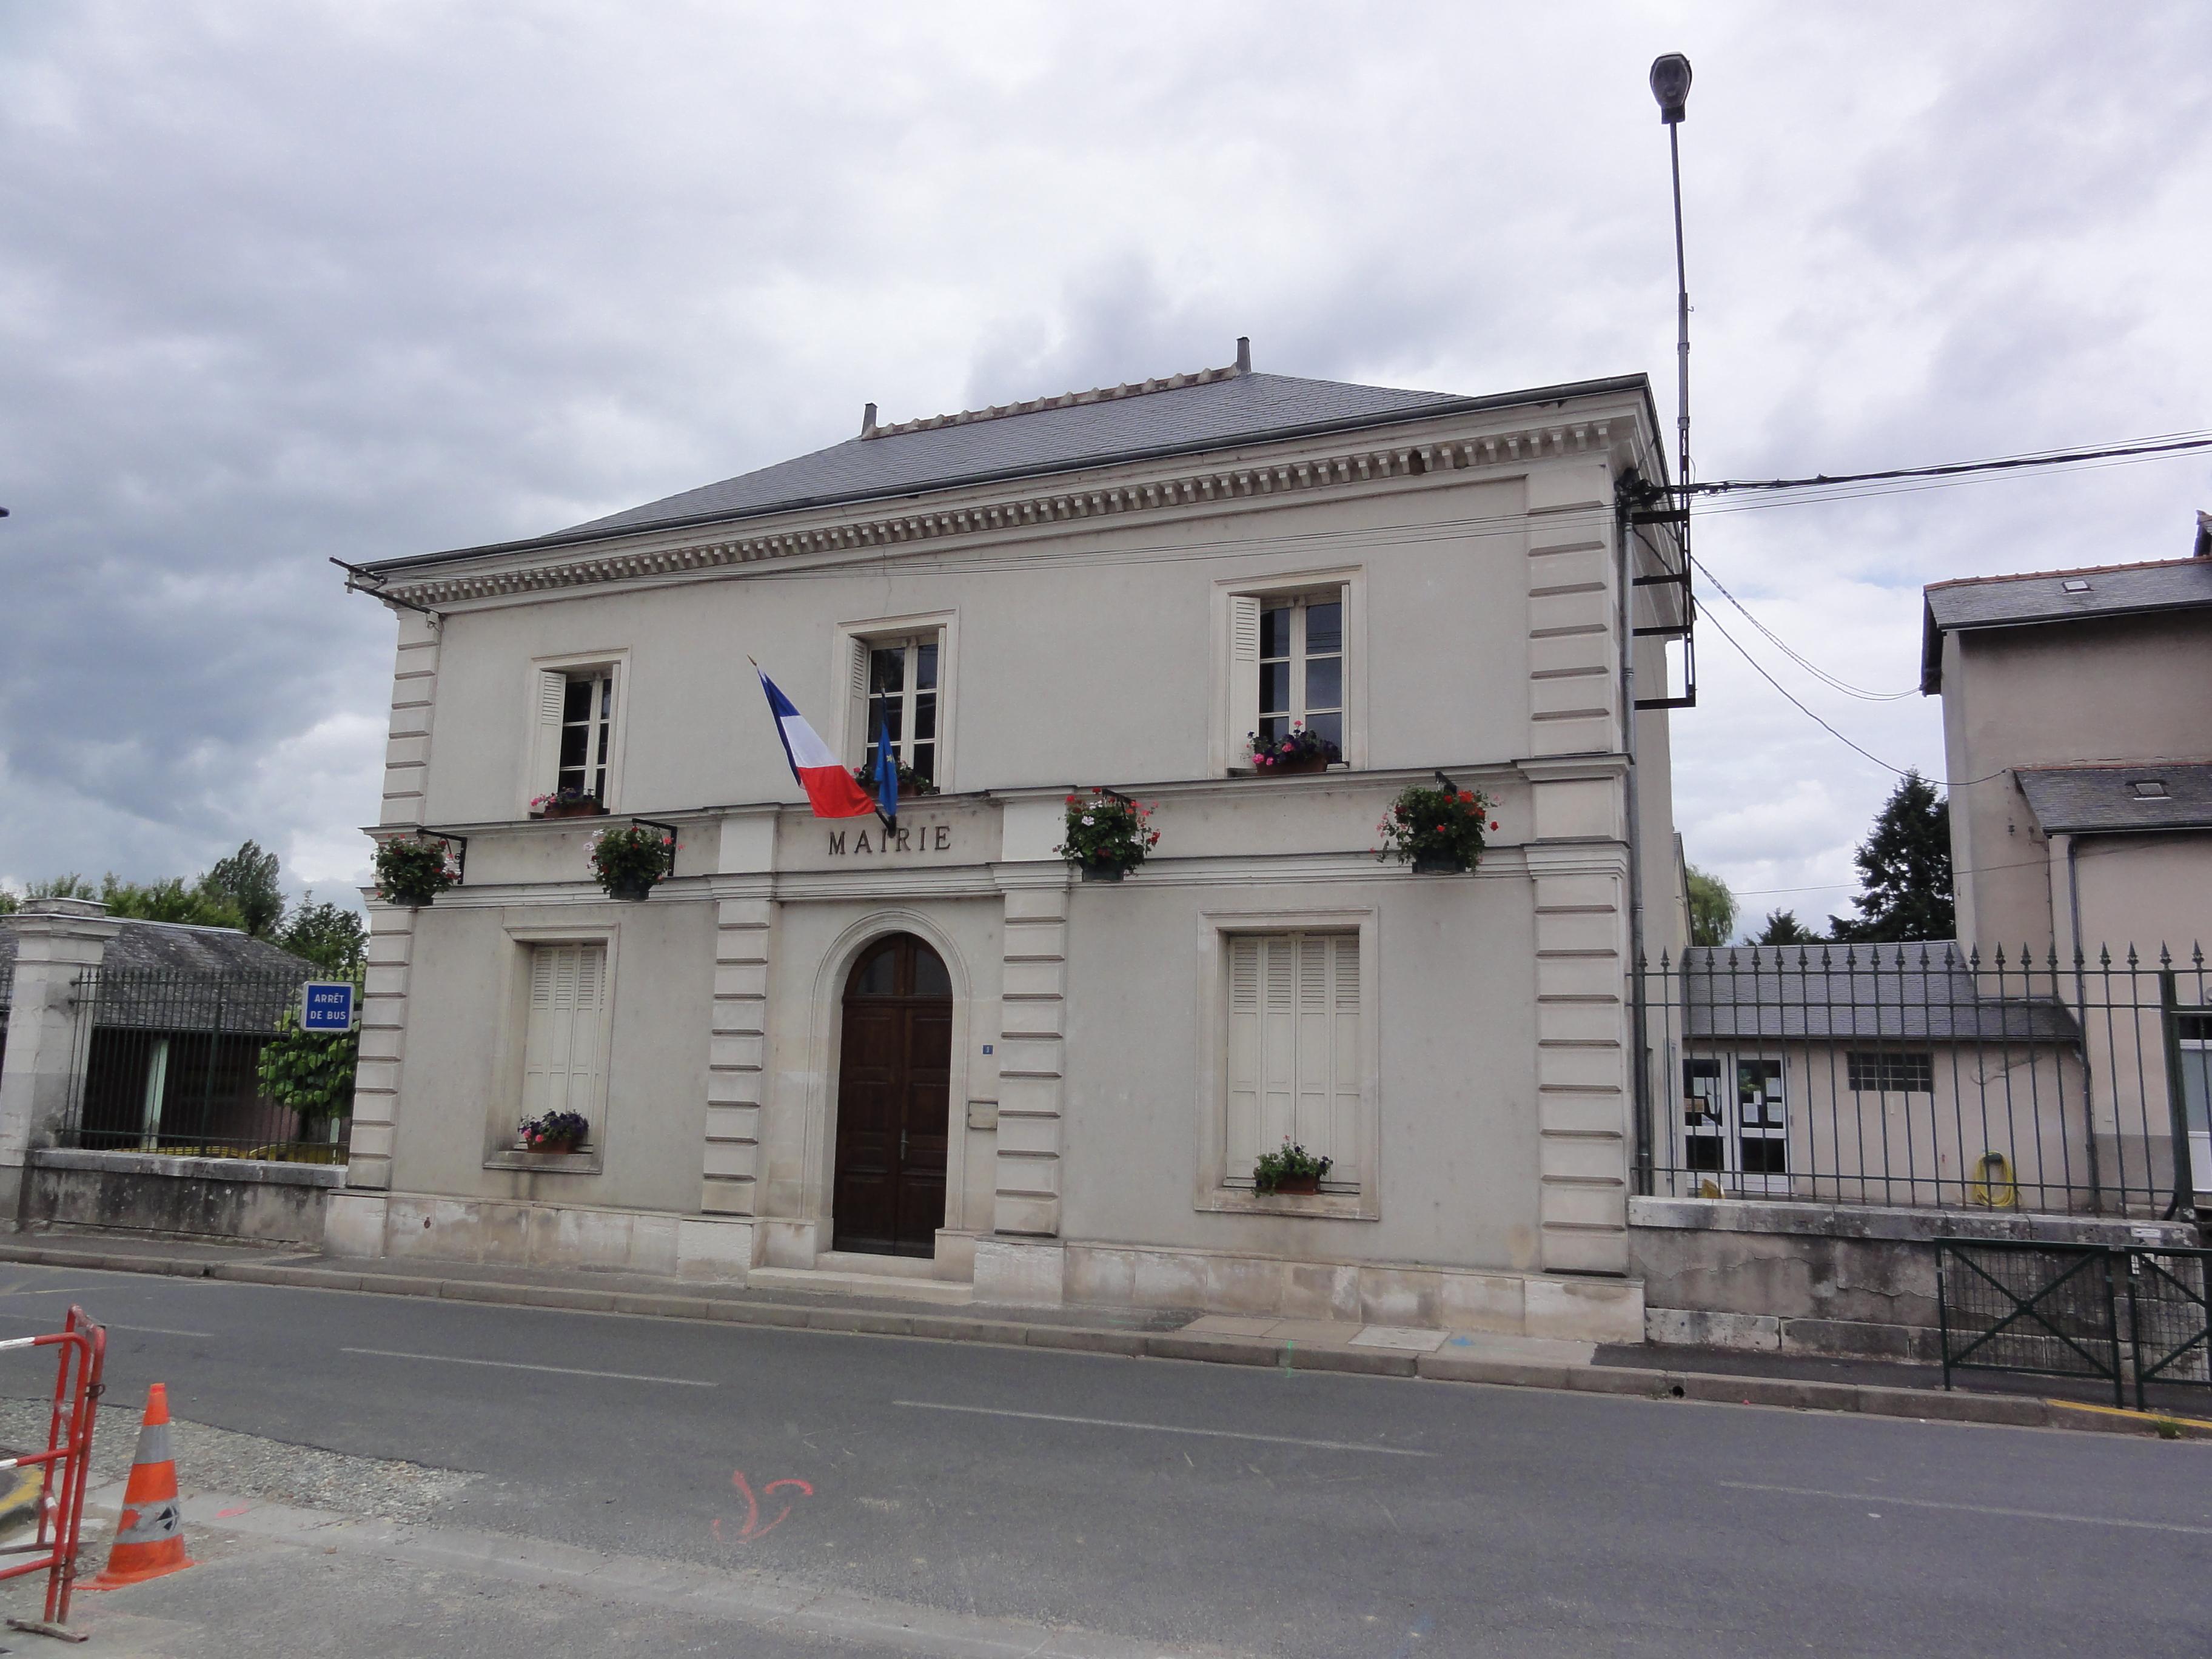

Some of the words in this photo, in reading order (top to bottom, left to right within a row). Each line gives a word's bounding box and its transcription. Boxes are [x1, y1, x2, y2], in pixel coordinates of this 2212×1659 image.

[828, 826, 951, 855] MAIRIE
[314, 993, 344, 1004] ARRÊT
[310, 1010, 323, 1019] DE
[327, 1011, 346, 1020] BUS
